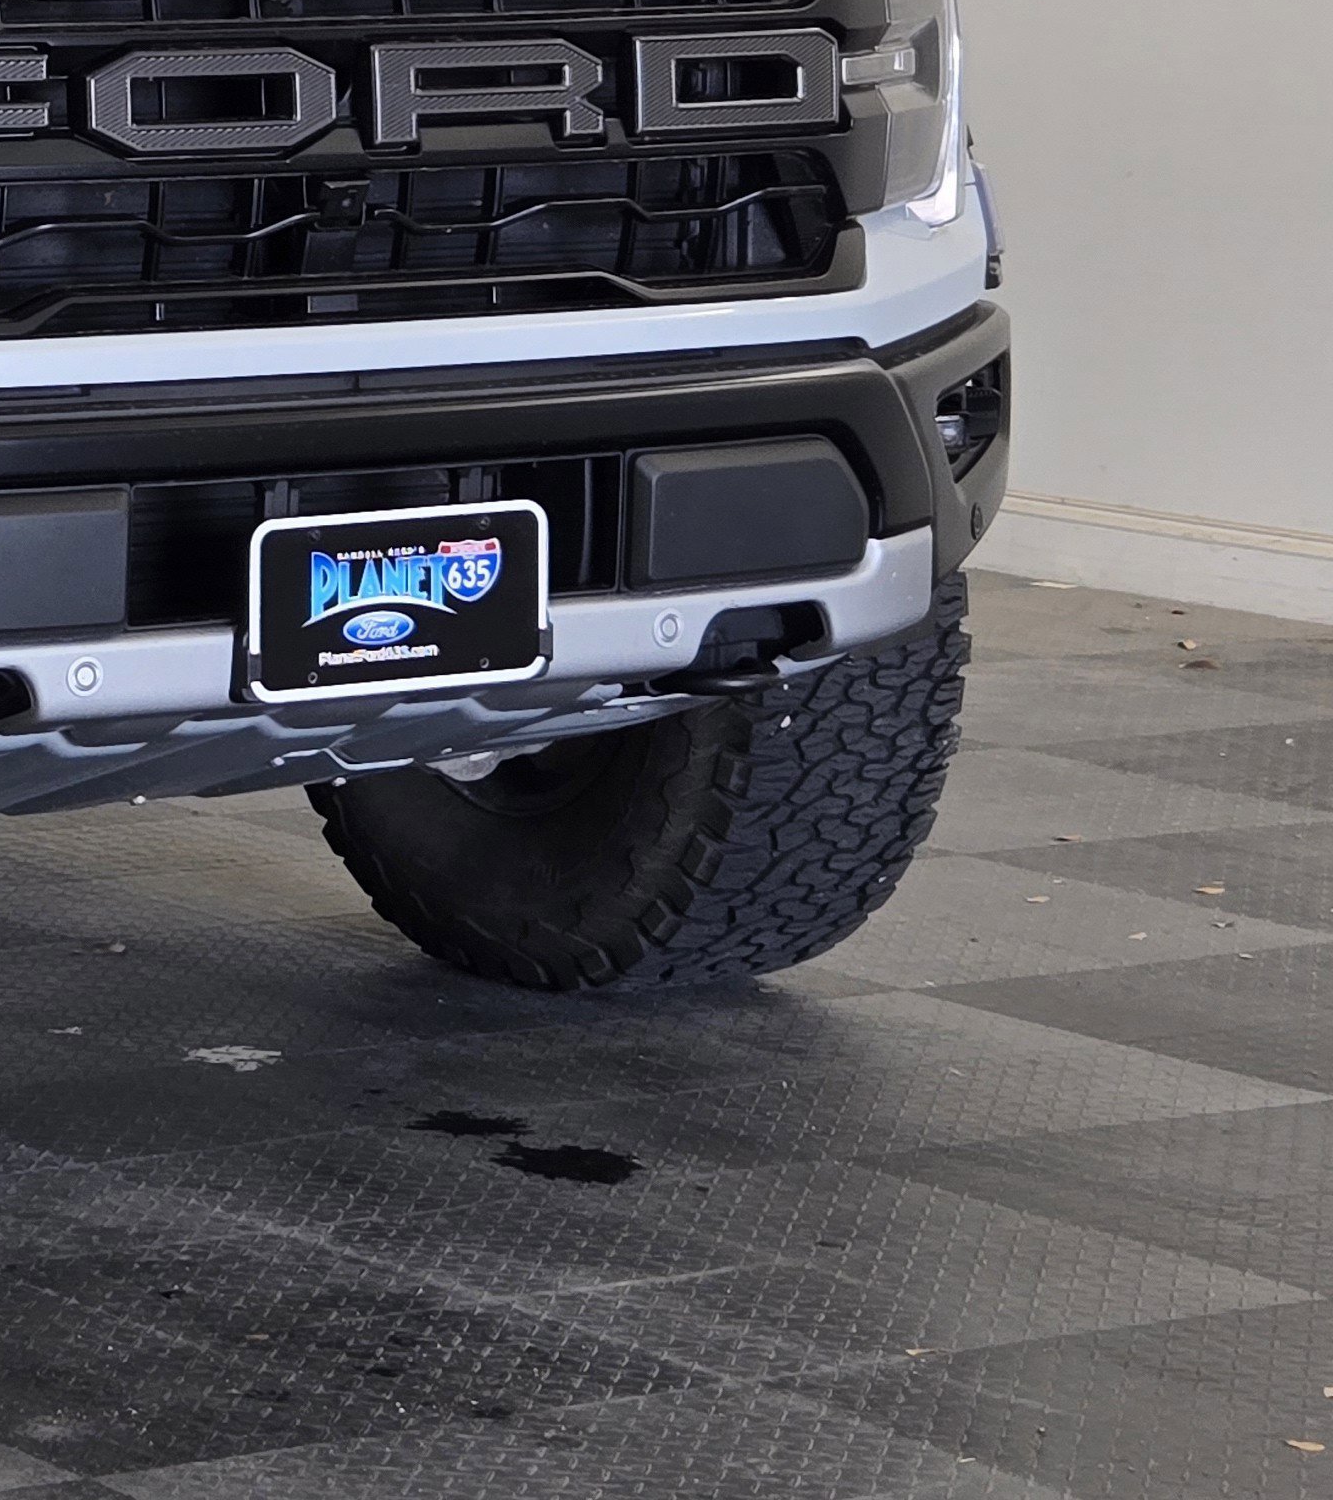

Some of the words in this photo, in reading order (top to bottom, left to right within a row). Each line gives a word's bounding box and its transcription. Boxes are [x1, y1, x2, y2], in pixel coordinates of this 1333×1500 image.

[311, 551, 446, 618] PLANET
[448, 559, 491, 589] 635
[356, 618, 400, 640] Ford
